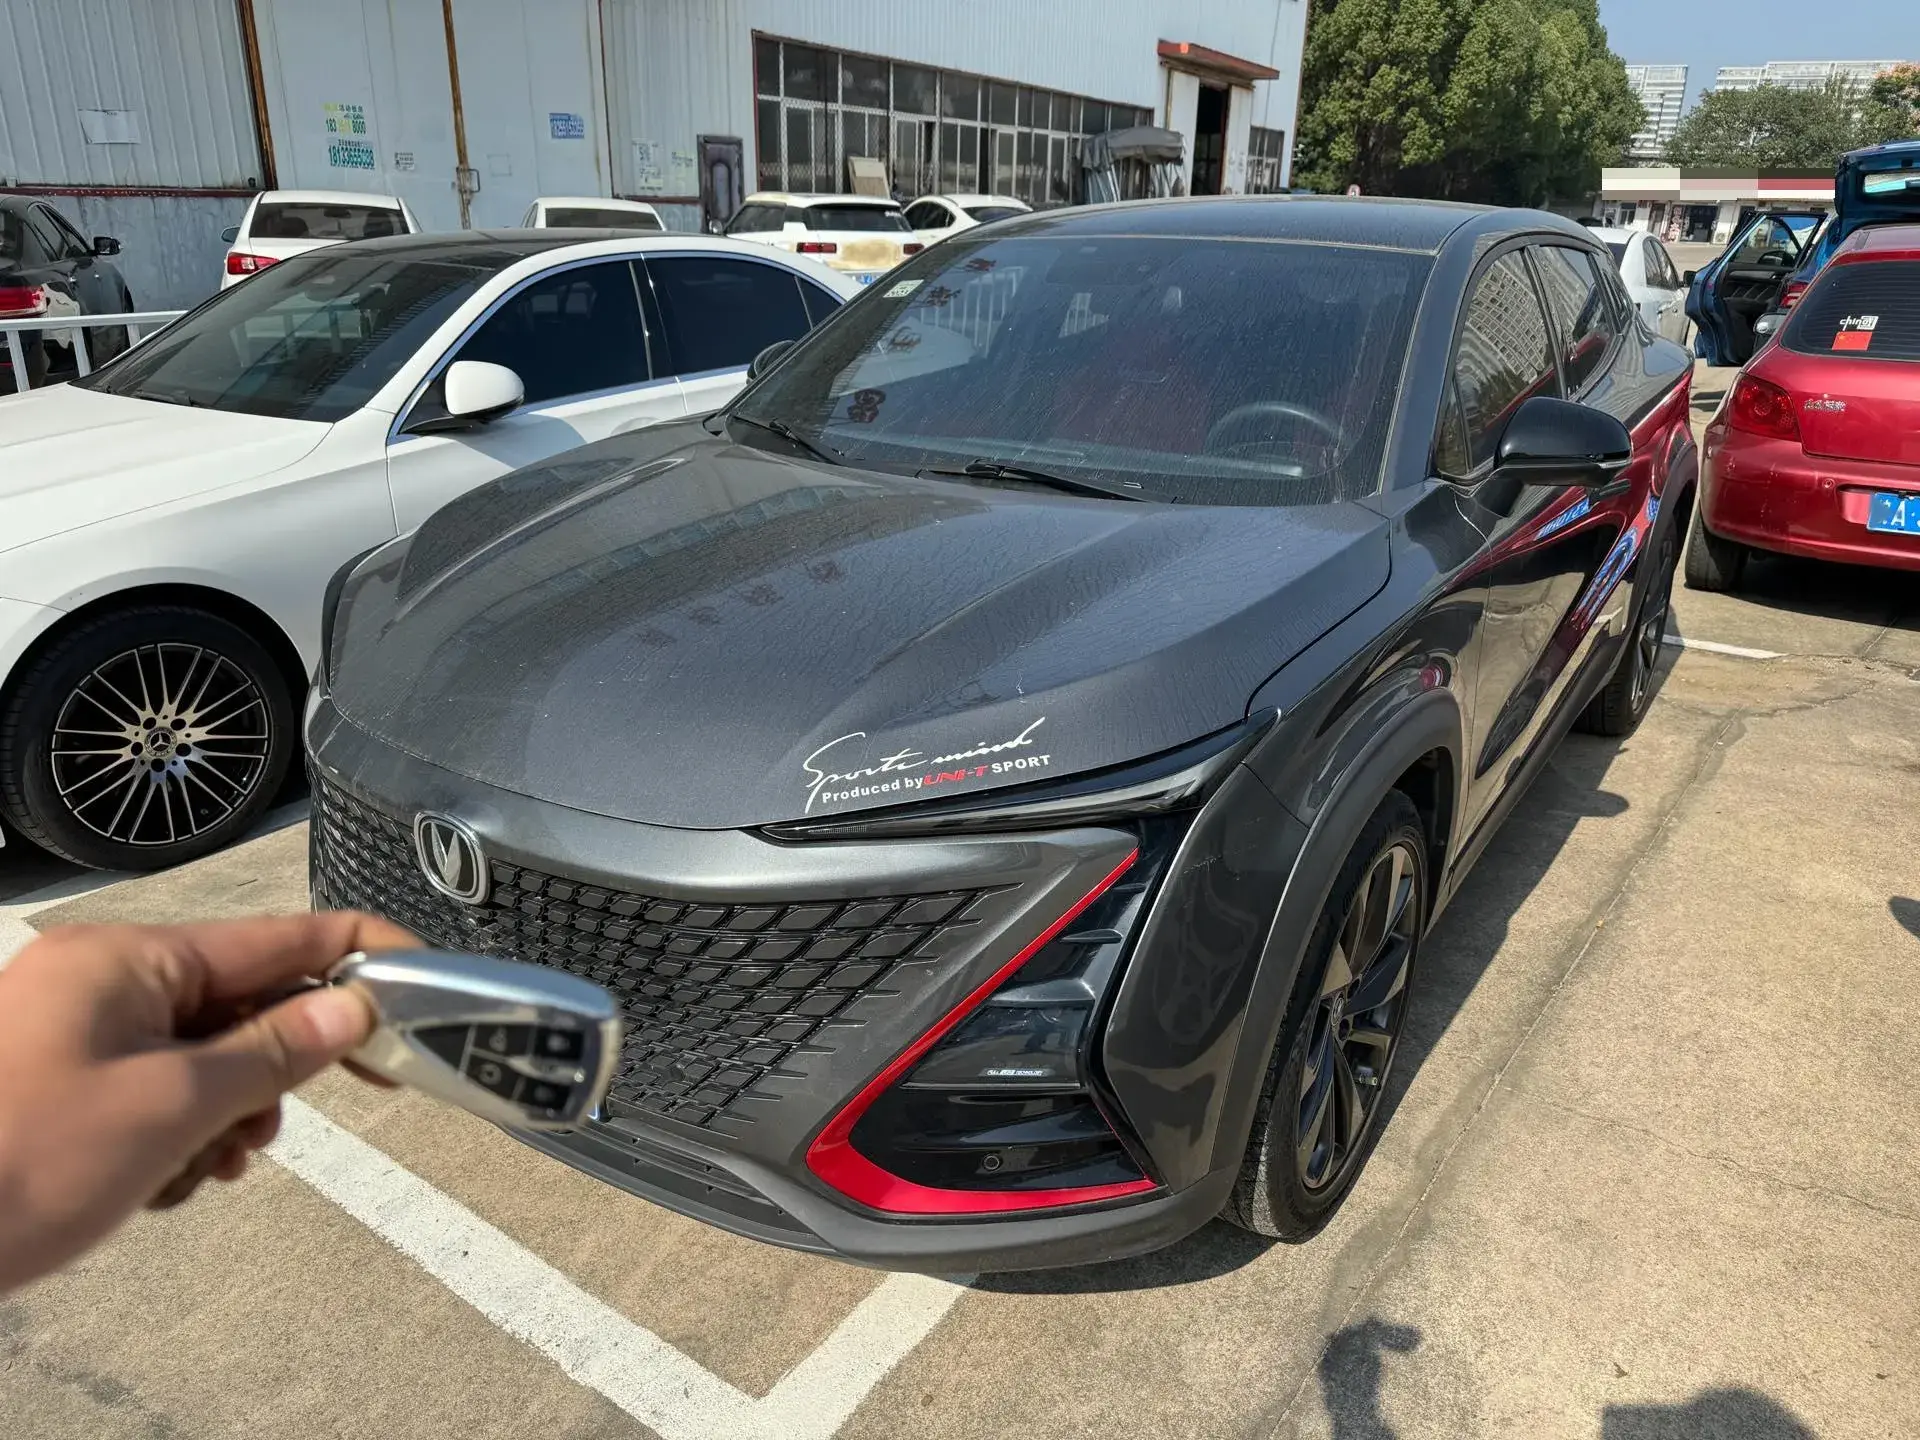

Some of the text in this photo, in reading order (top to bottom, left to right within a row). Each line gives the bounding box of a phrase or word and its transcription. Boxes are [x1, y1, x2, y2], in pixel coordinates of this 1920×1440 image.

[931, 716, 1046, 765] mind
[822, 754, 1052, 804] Produced by UNI-T SPORT
